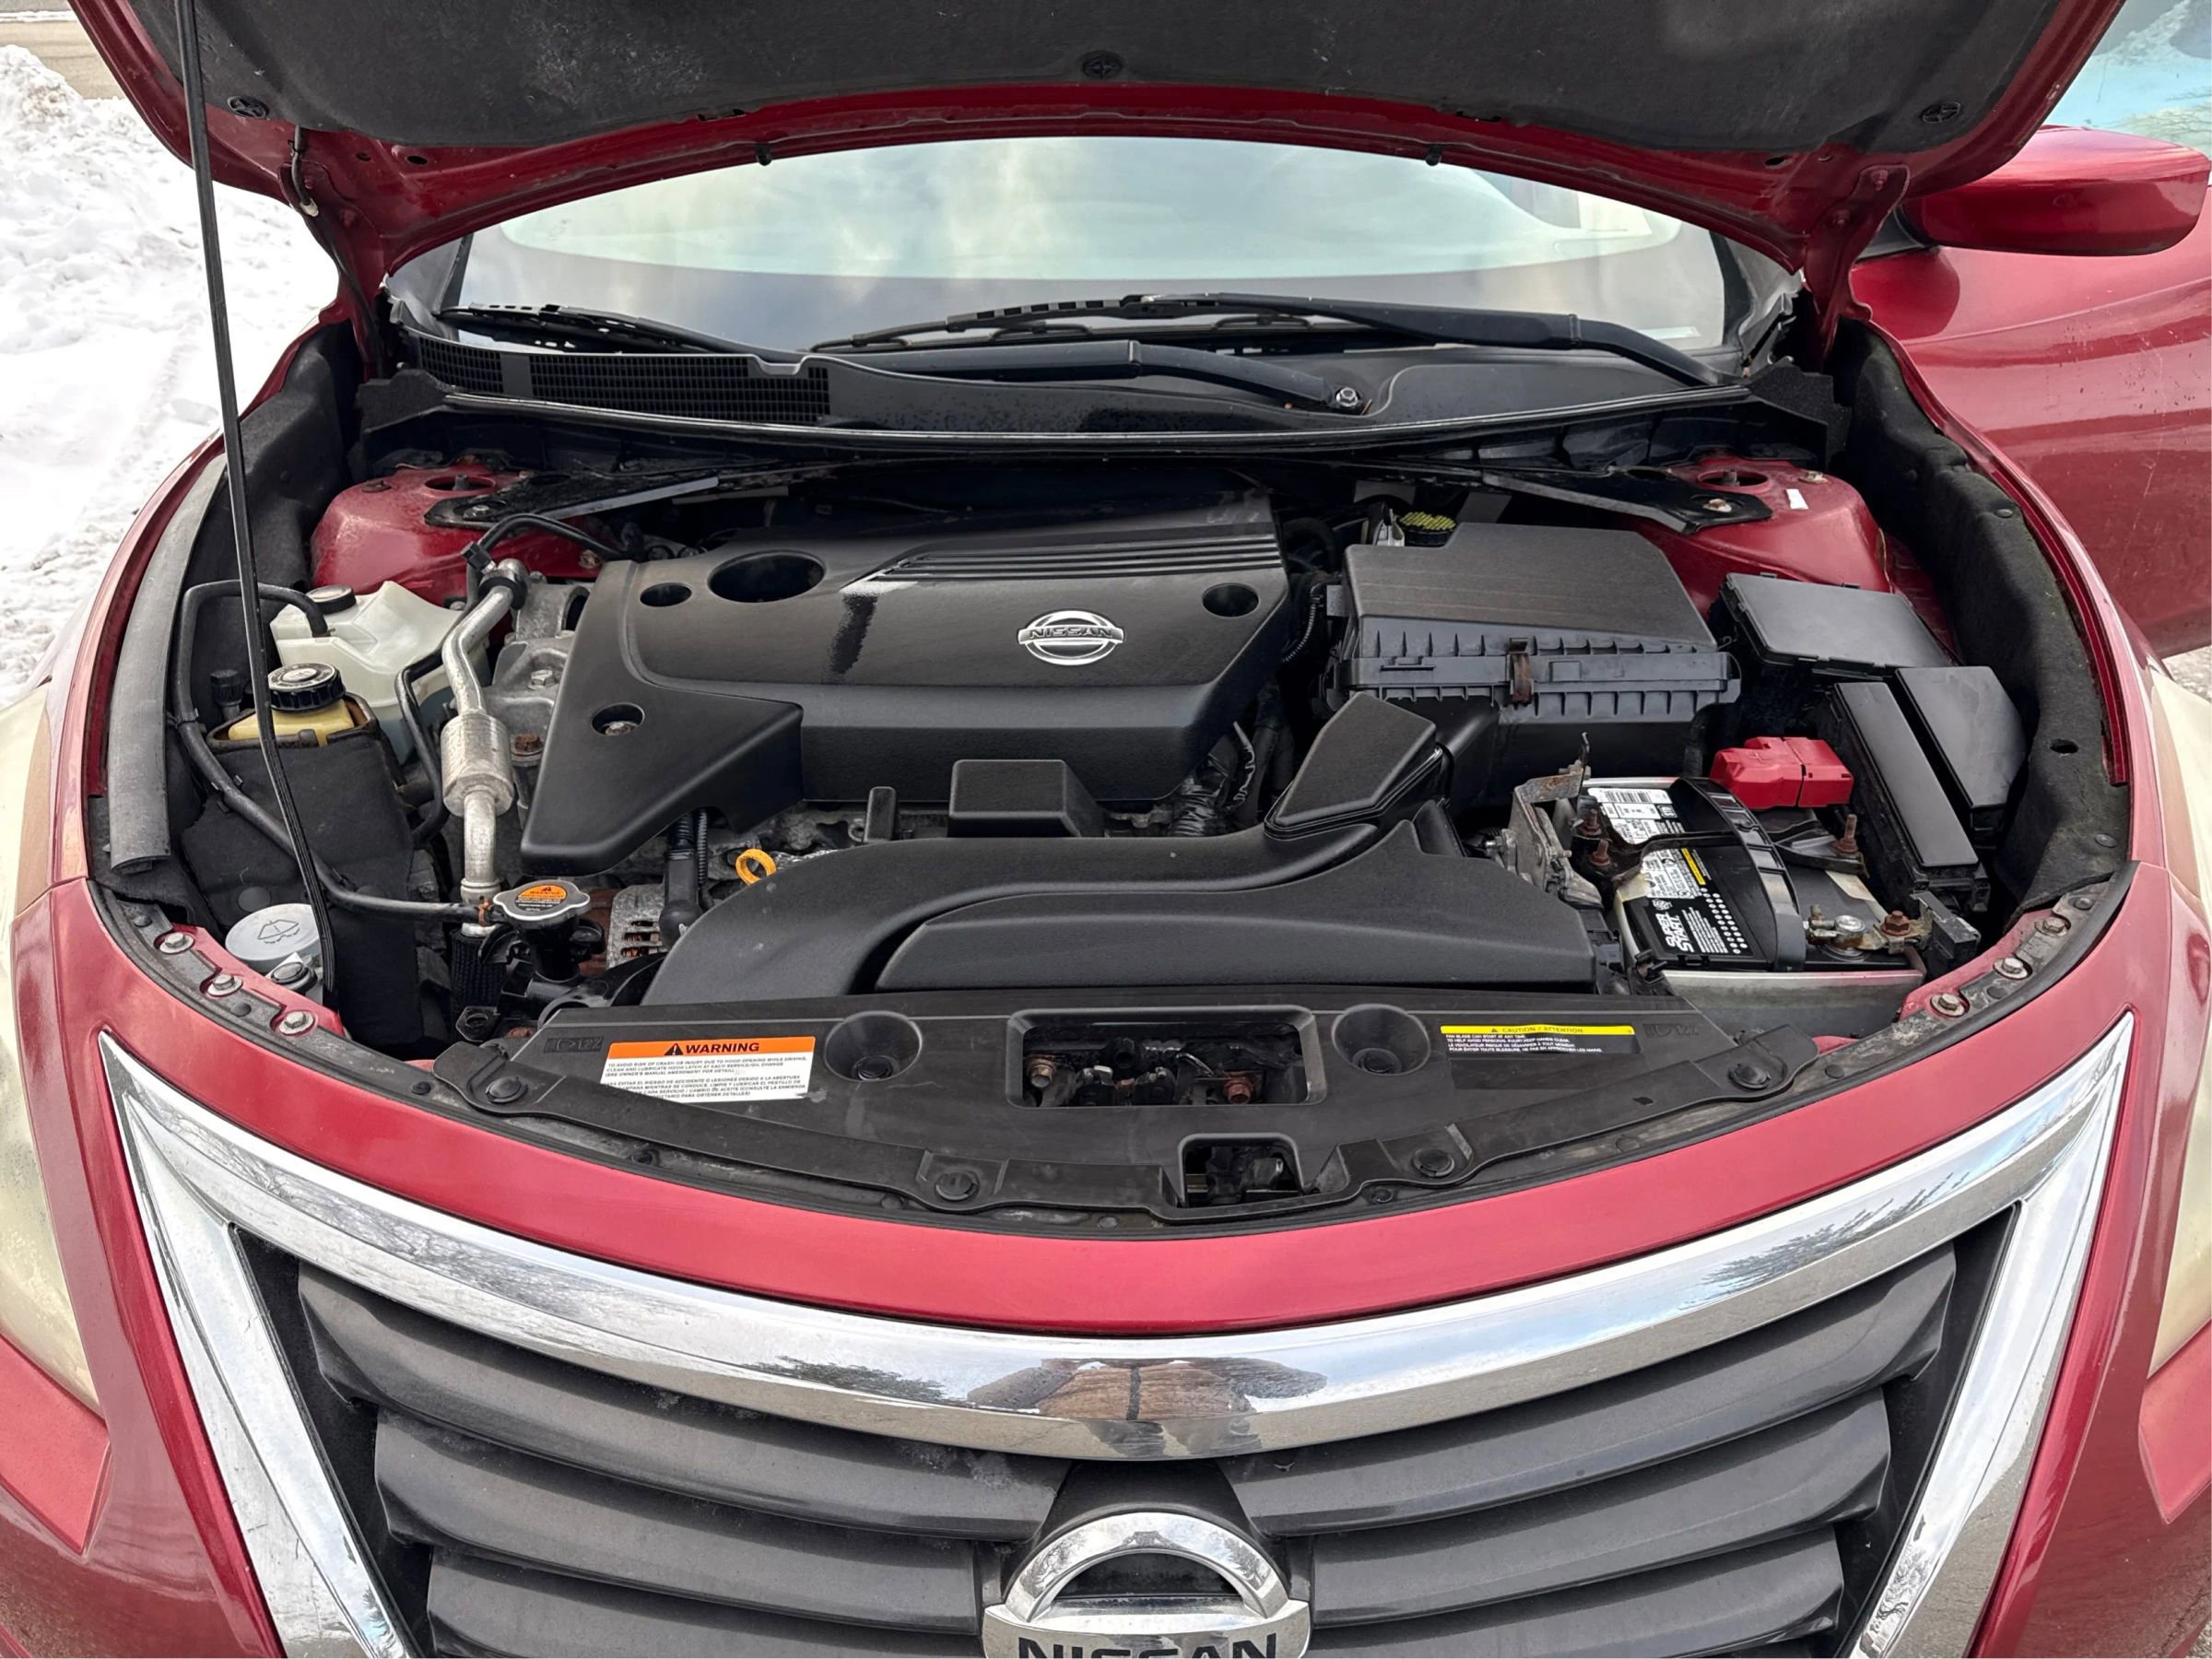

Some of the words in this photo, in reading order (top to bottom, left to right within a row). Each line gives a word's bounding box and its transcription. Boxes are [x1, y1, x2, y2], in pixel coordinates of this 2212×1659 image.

[1030, 627, 1112, 639] NISSAN
[1655, 912, 1676, 947] SUPER
[1665, 912, 1694, 952] START
[685, 1042, 760, 1053] WARNING
